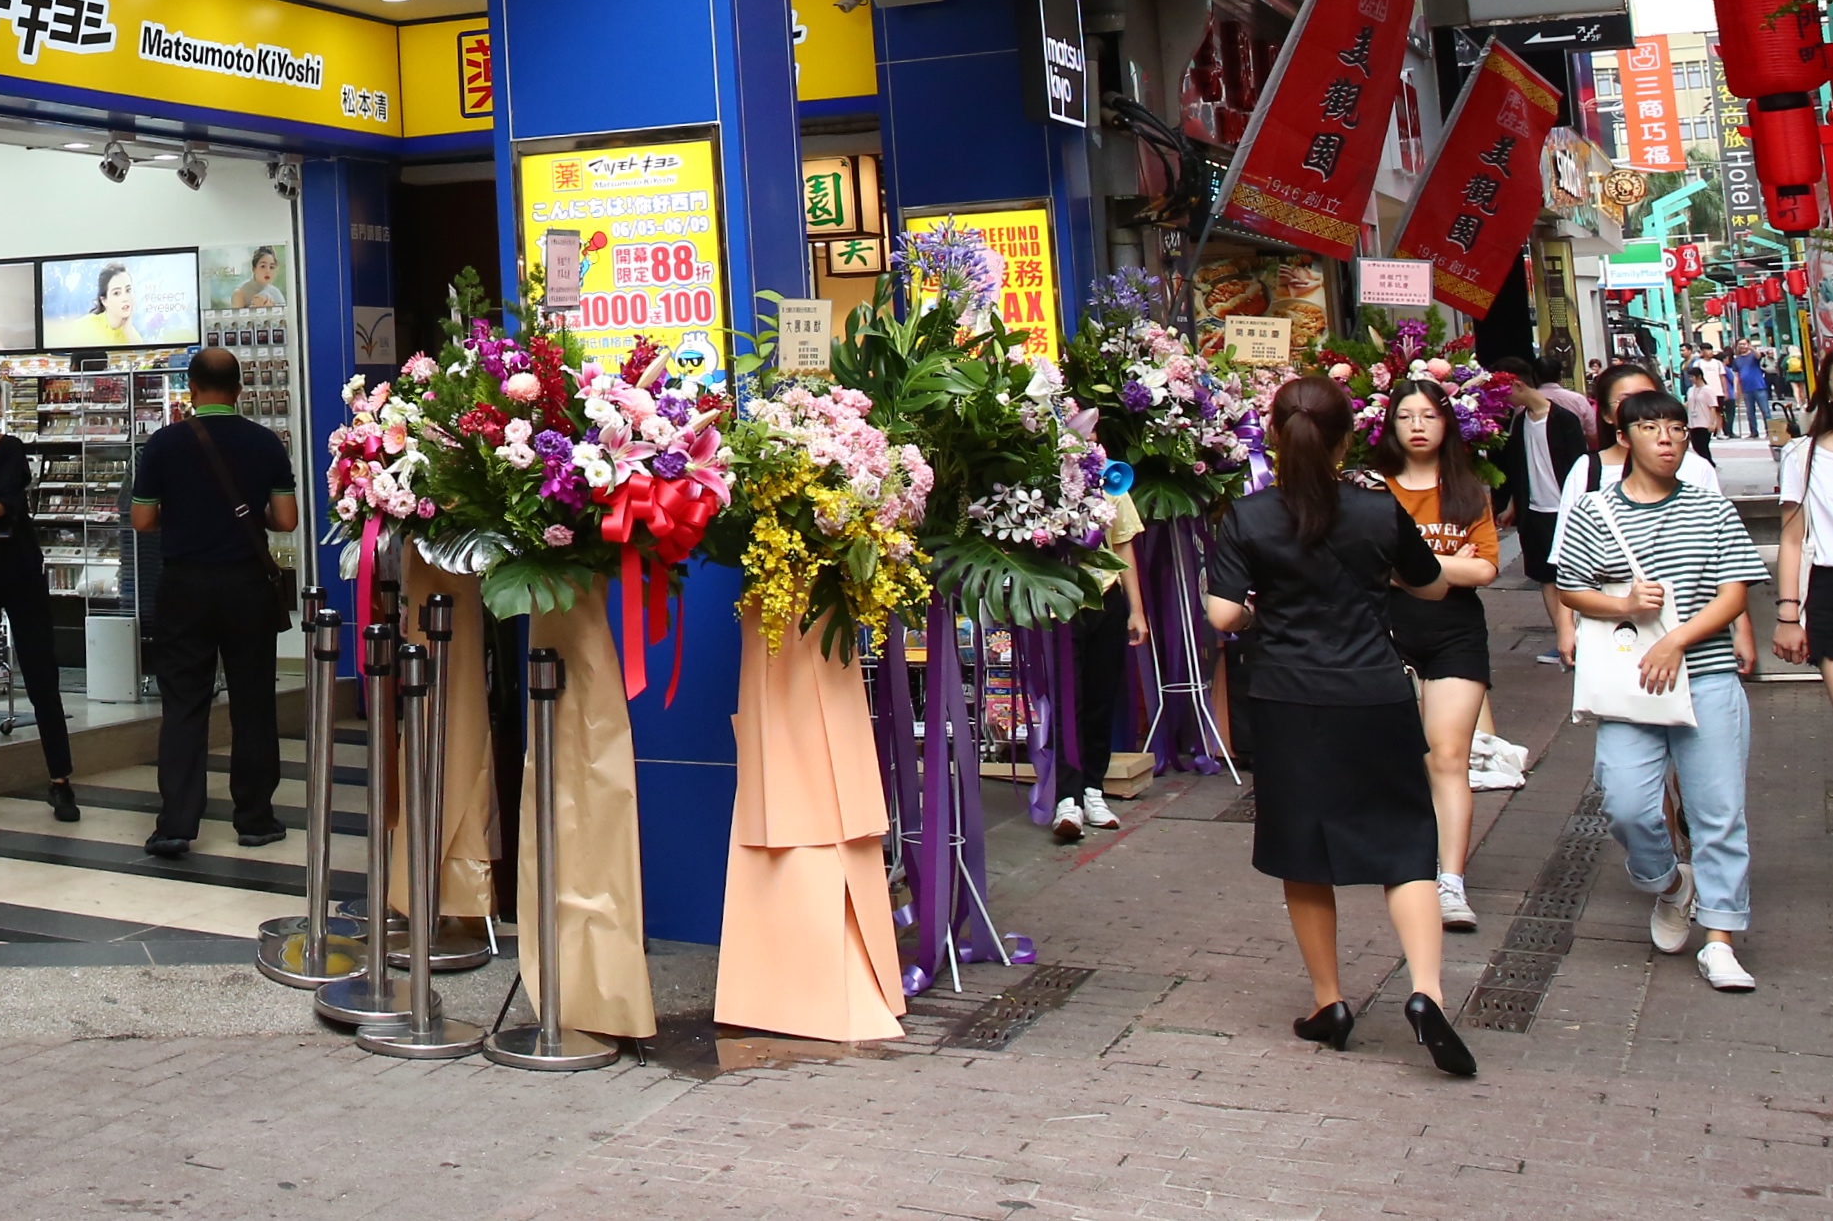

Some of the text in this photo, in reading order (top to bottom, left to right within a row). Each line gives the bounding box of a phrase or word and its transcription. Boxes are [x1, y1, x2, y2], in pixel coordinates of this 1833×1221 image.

[1591, 34, 1602, 42] 2F
[141, 24, 321, 86] Matsumoto KiYoshi
[1047, 36, 1082, 73] matsu
[342, 86, 388, 122] 松本清
[1050, 69, 1072, 115] kiyo
[1635, 76, 1671, 165] 三商巧福
[555, 162, 580, 189] 薬
[588, 155, 679, 176] マツモトキヨシ
[594, 178, 642, 189] Matsumoto
[1726, 151, 1758, 210] Hotel
[805, 172, 844, 227] 園
[1266, 177, 1342, 216] 1946 創立
[611, 216, 709, 239] 06/05-06/09
[616, 247, 648, 266] 開幕
[993, 241, 1041, 258] EFUND
[1418, 244, 1481, 284] 1946 創立
[1665, 257, 1674, 268] 0
[616, 266, 650, 283] 限定
[1610, 269, 1664, 278] FamilyMart
[1003, 291, 1046, 323] AX
